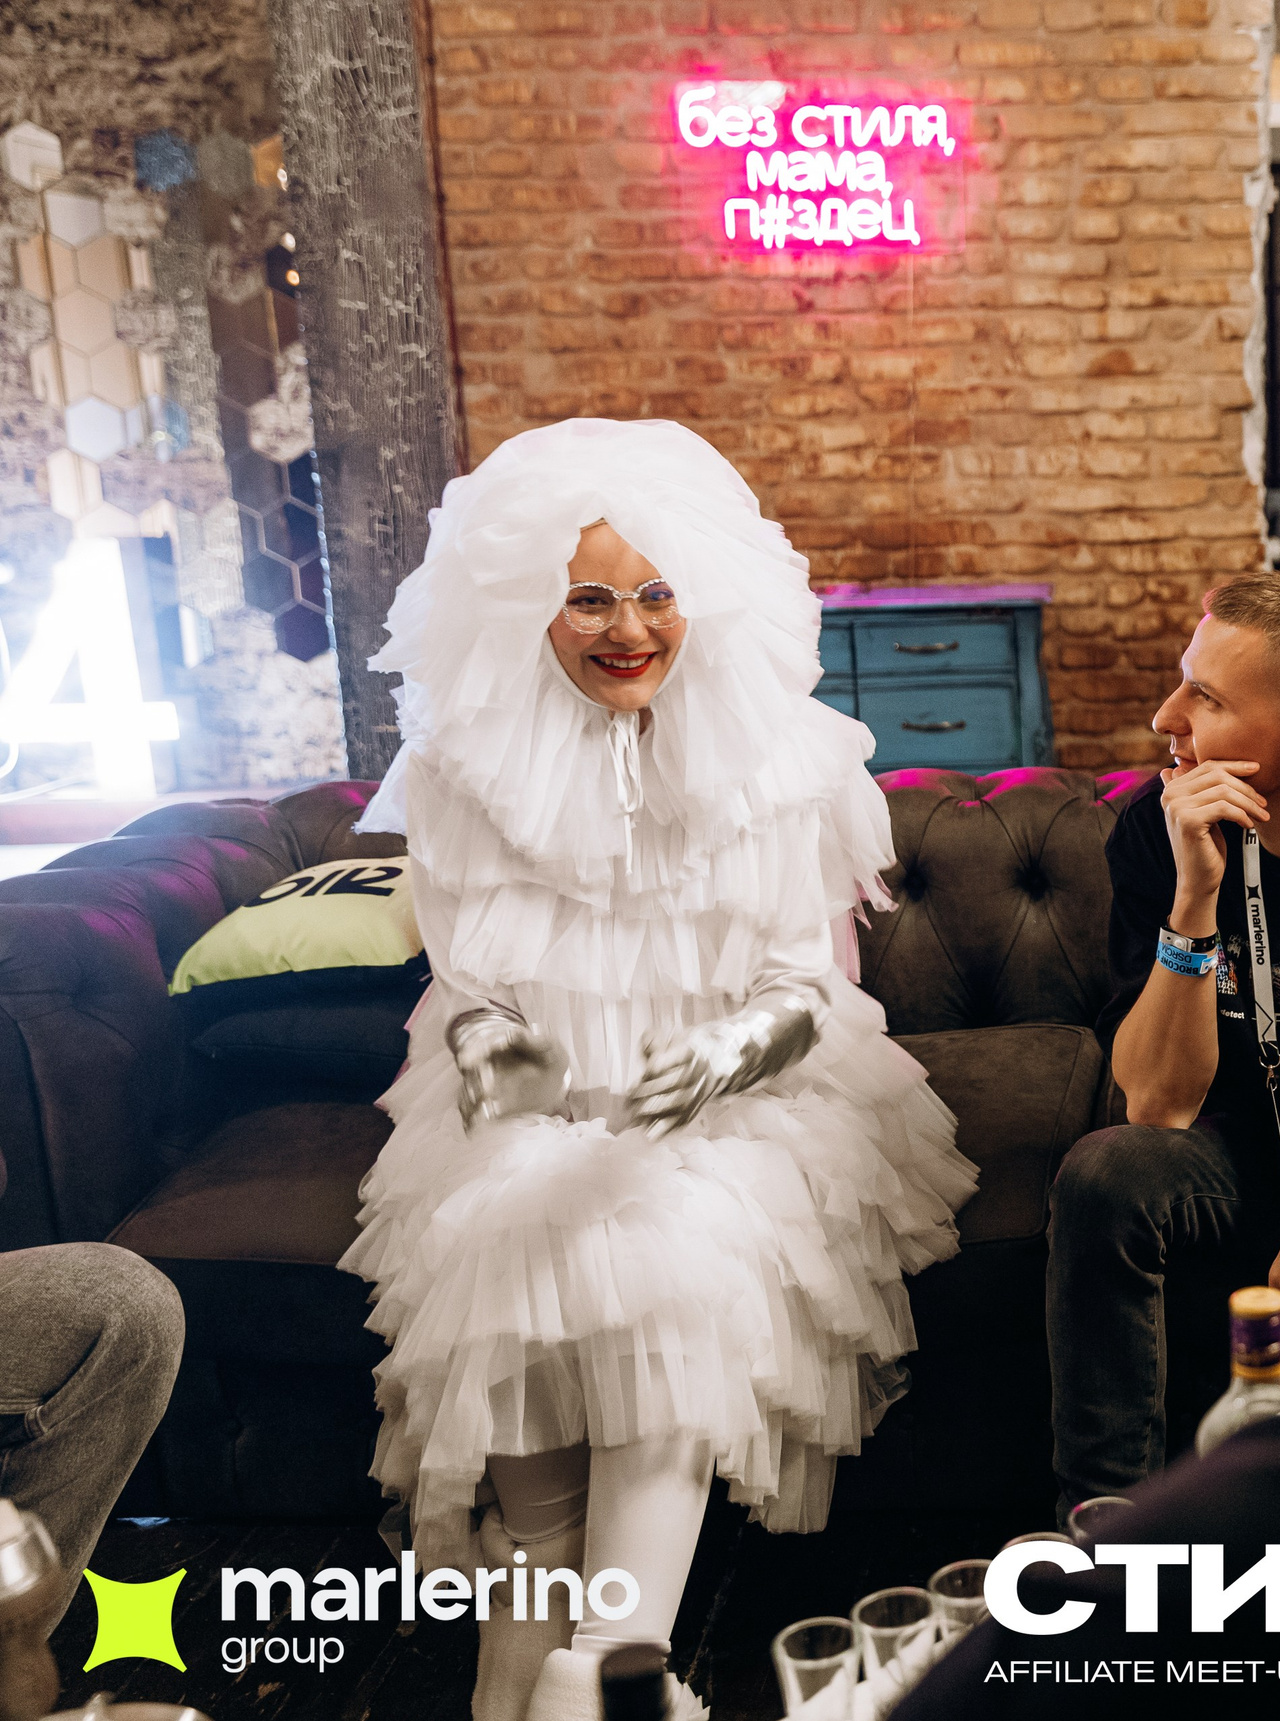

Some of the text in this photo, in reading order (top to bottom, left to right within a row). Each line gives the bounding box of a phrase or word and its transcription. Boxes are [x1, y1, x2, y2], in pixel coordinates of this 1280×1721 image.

[678, 86, 956, 156] без стиля,
[746, 150, 893, 199] мама,
[724, 193, 920, 249] п#здец
[1251, 904, 1265, 966] marlerino
